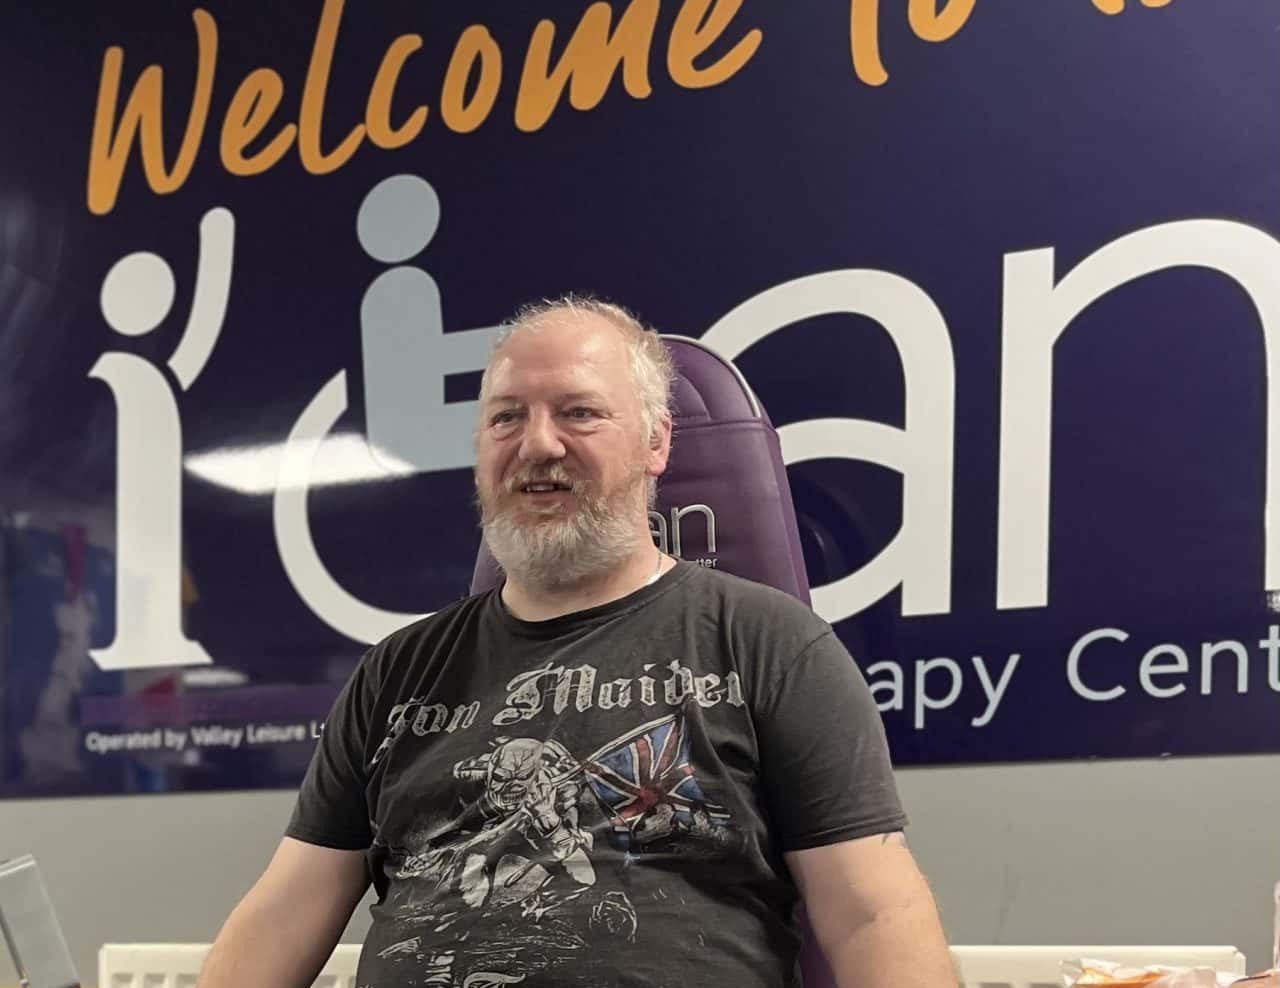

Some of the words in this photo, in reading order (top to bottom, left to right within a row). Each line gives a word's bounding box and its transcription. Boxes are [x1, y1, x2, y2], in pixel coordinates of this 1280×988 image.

[87, 0, 762, 215] Welcome
[85, 730, 161, 754] Operated
[164, 729, 187, 750] by
[190, 725, 243, 748] Valley
[246, 722, 305, 744] Leisure
